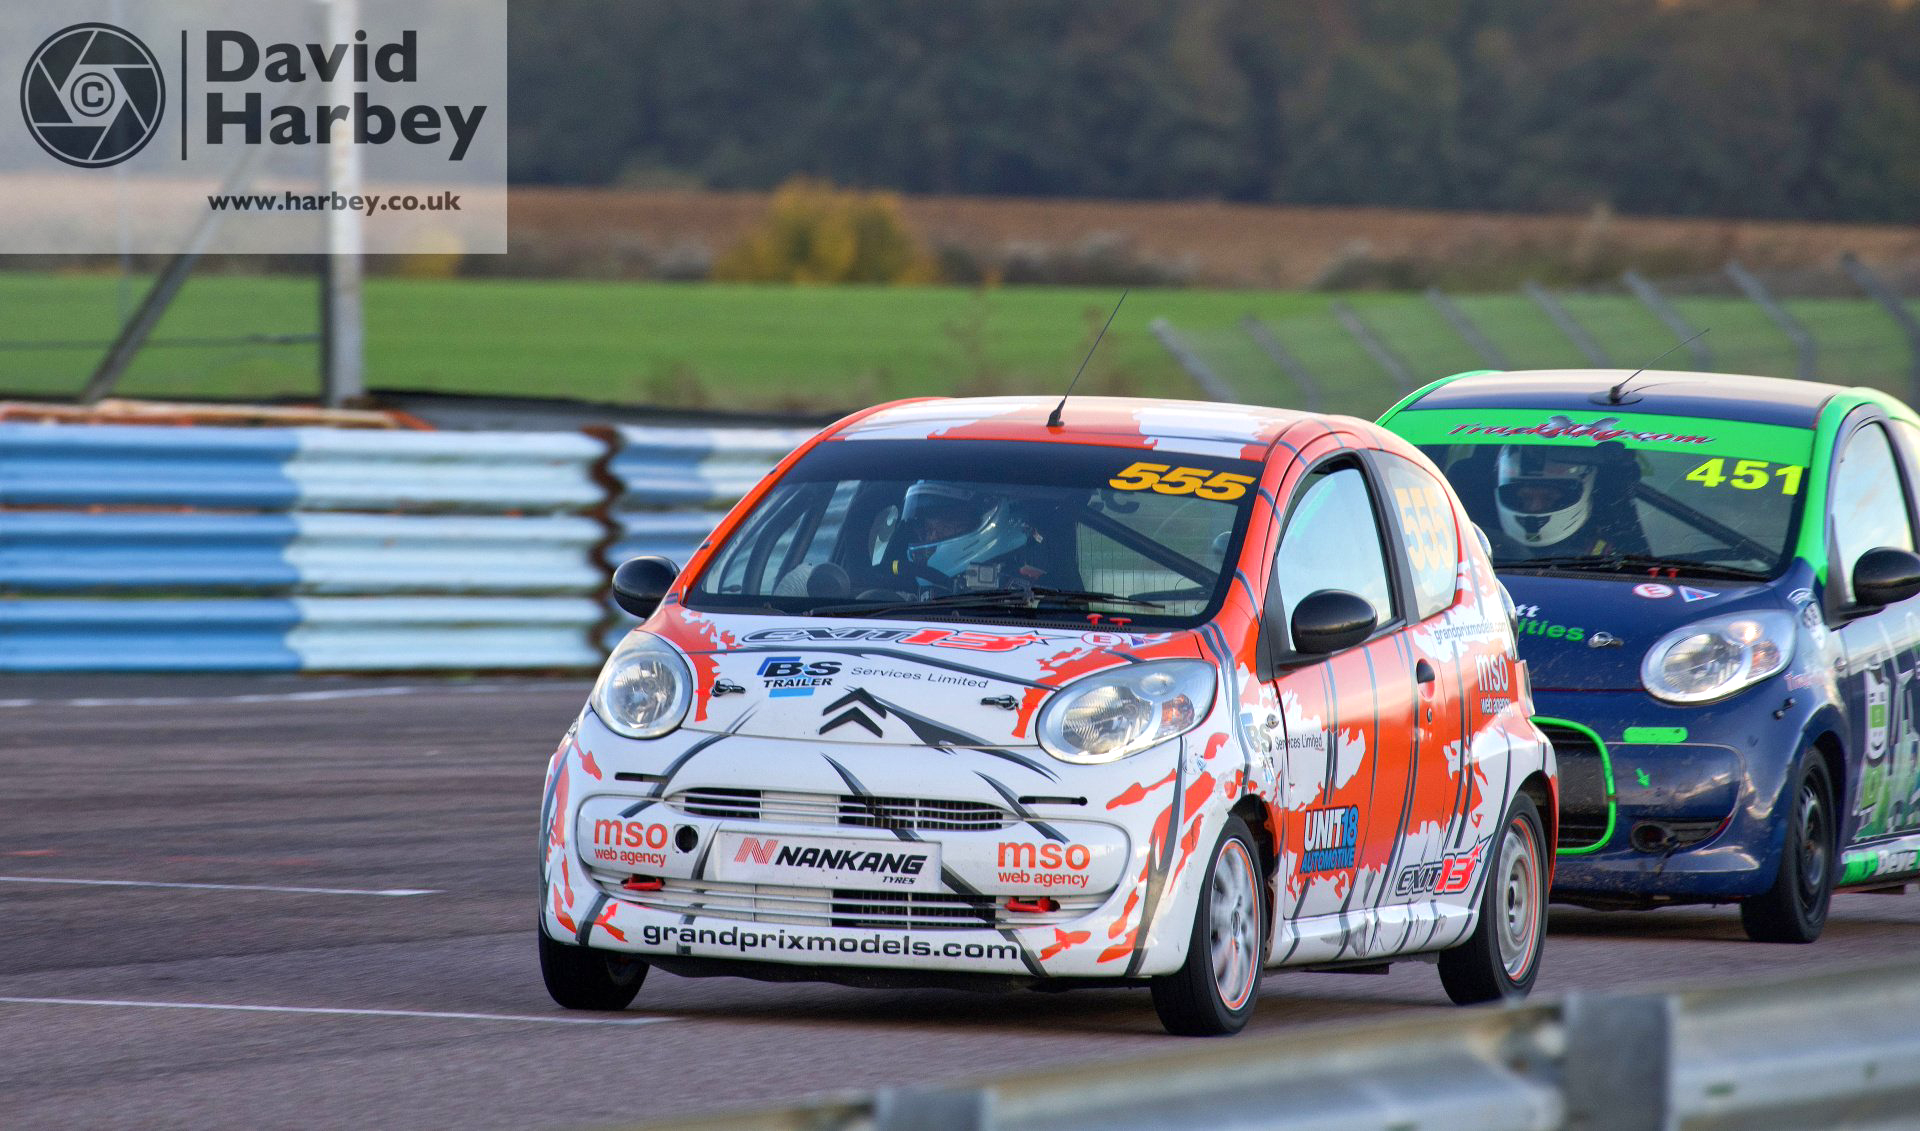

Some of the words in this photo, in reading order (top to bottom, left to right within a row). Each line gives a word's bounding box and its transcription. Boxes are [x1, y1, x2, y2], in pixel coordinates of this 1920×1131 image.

[1109, 462, 1257, 500] 555
[1686, 458, 1803, 495] 451
[1395, 487, 1456, 571] 555
[763, 678, 833, 688] TRAILER
[851, 666, 922, 682] Services
[928, 673, 989, 689] Limited
[1475, 654, 1509, 692] mso
[1301, 733, 1323, 749] Limited
[594, 818, 668, 849] mso
[594, 848, 618, 861] web
[620, 851, 666, 868] agency
[775, 845, 928, 875] NANKANG
[998, 842, 1091, 870] mso
[1301, 847, 1355, 873] AUTOMOTIVE
[882, 876, 916, 885] TYRES
[998, 870, 1030, 883] web
[1034, 872, 1089, 888] agency
[643, 925, 1018, 959] grandprixmodels.com
